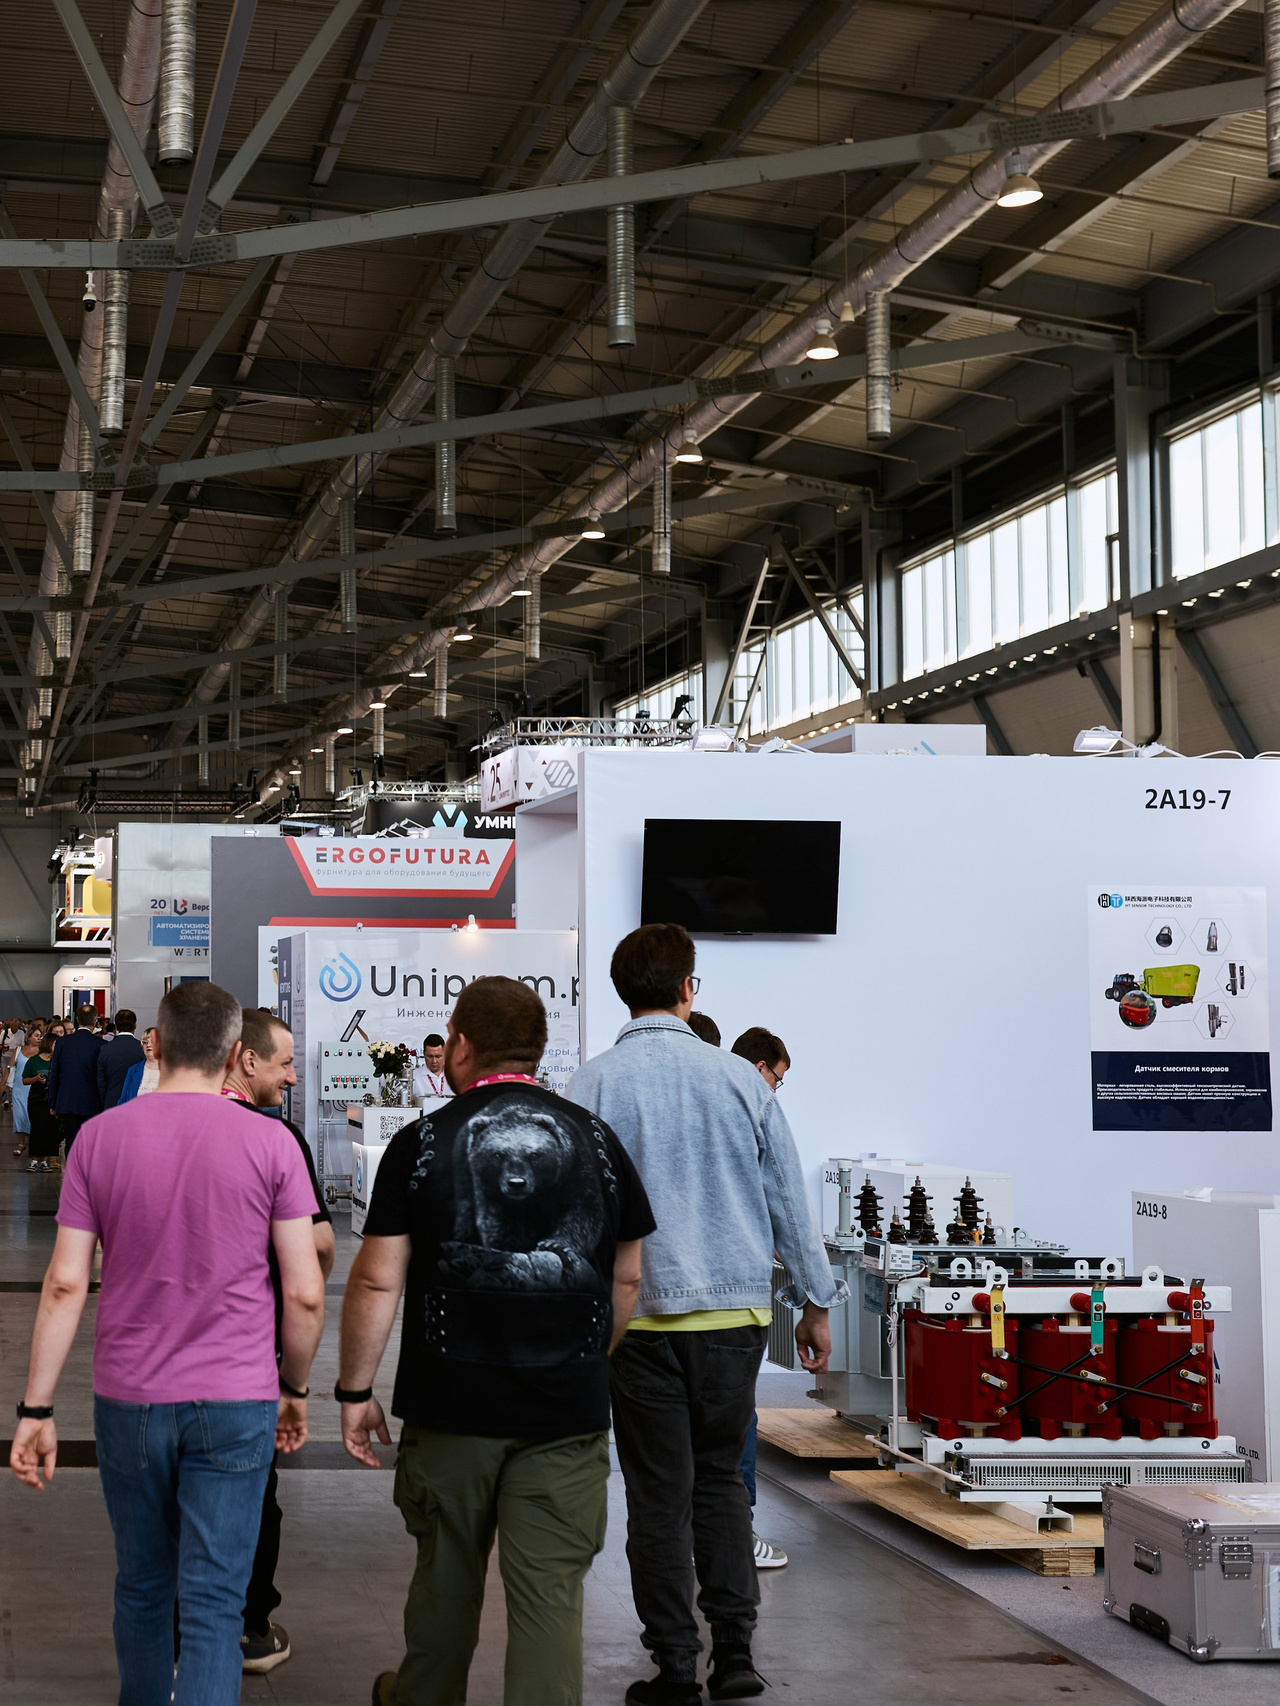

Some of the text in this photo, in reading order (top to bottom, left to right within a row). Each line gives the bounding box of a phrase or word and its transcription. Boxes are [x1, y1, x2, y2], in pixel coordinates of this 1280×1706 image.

[1145, 788, 1231, 810] 2A19-7
[315, 847, 491, 865] ERGOFUTURA
[315, 868, 491, 878] фурнитура для оборудования будущего
[150, 899, 167, 909] 20
[397, 1008, 452, 1019] Инжене
[1134, 1064, 1161, 1074] Датчик
[1201, 1066, 1230, 1074] кормов
[1136, 1200, 1168, 1220] 2A19-8
[1249, 1449, 1260, 1460] LTD.
